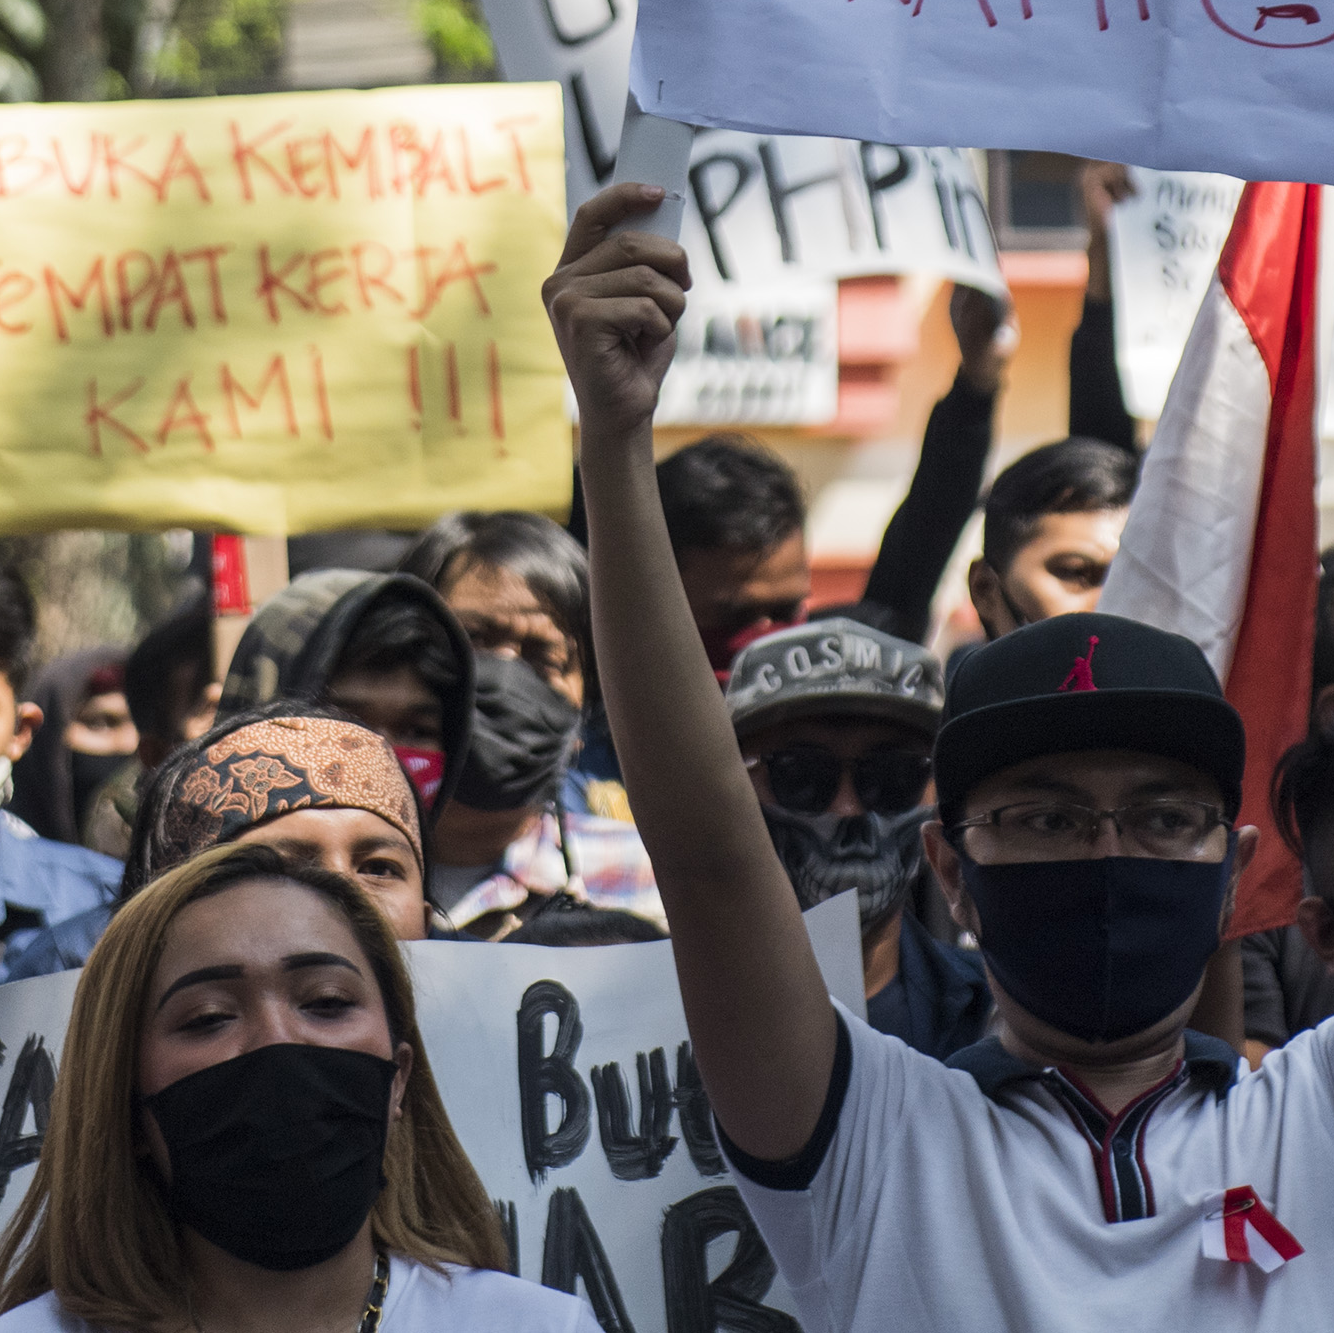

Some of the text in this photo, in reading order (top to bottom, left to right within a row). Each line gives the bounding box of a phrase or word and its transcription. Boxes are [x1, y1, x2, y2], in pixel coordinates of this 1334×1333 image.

[256, 236, 499, 324] KERJA
[403, 338, 511, 461] !!!
[754, 628, 924, 699] COSMIC
